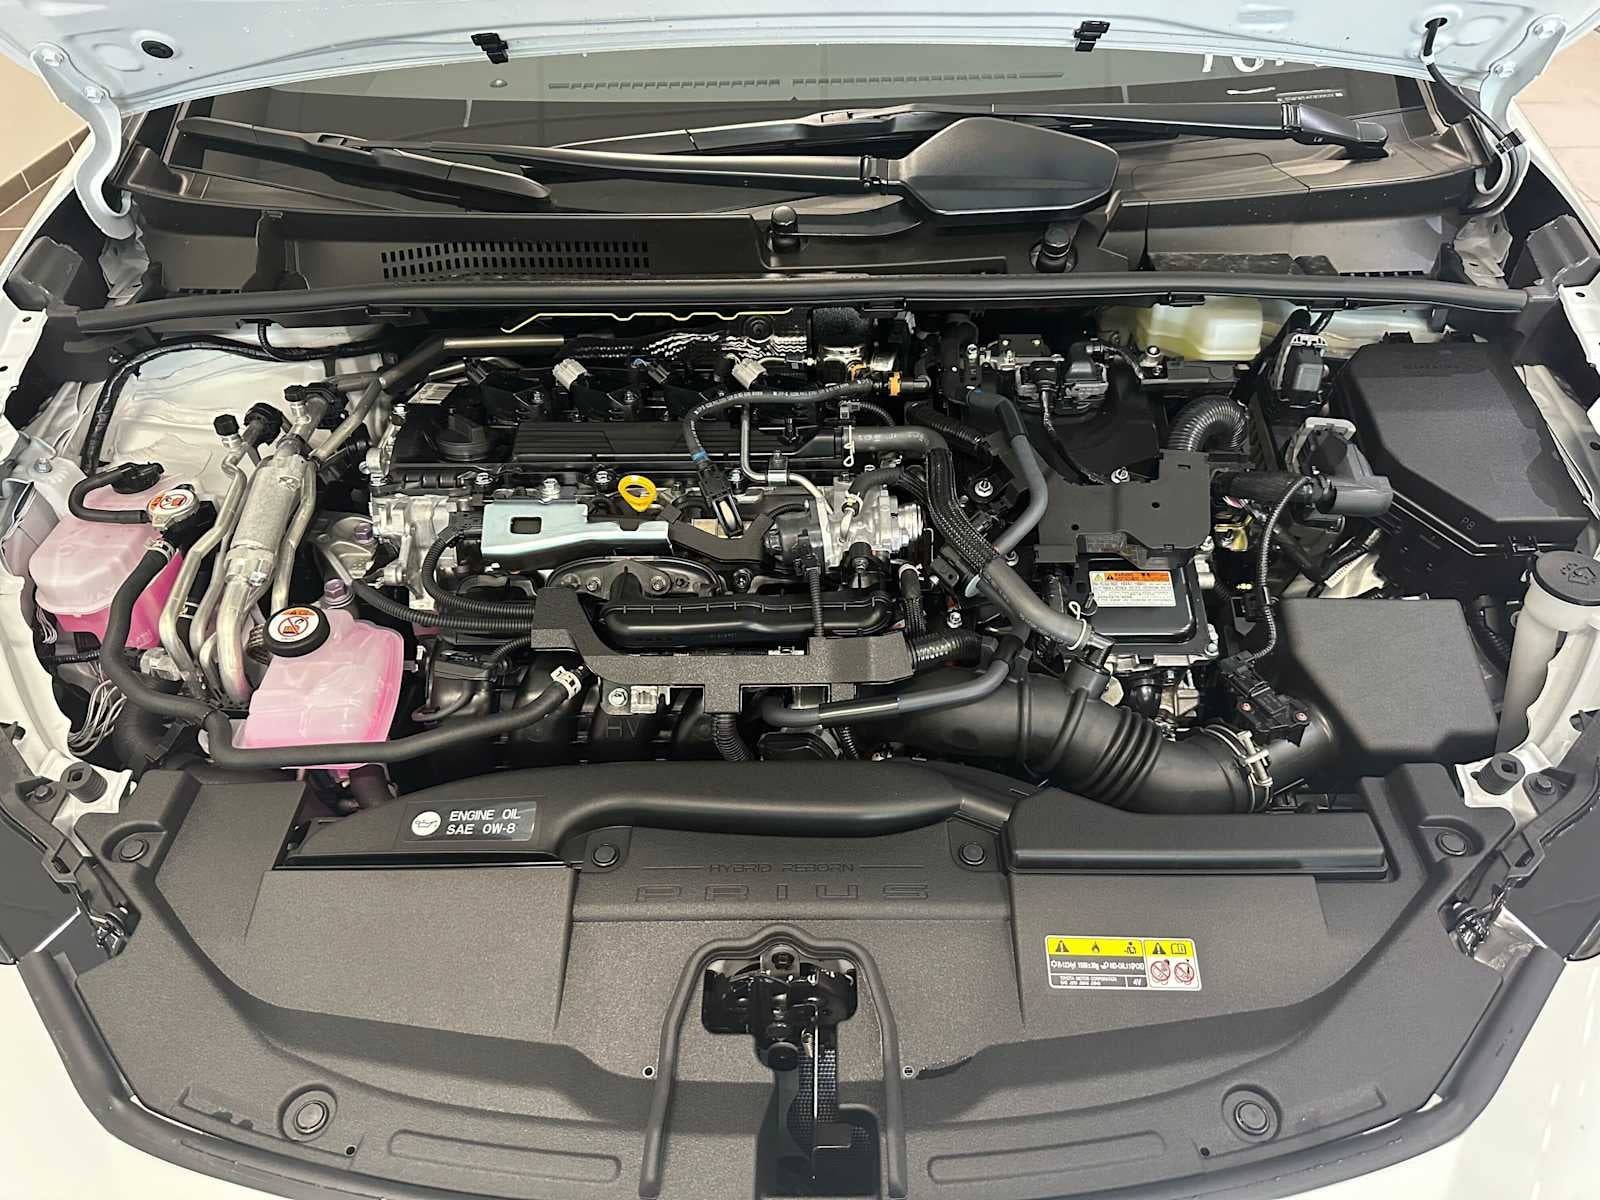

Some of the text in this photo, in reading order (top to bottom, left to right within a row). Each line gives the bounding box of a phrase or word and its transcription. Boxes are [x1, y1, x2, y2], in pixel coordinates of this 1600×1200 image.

[606, 718, 641, 738] HV
[450, 808, 521, 821] ENGINE OIL
[446, 823, 516, 835] SAE 0W-8
[708, 862, 855, 873] HYBRID REBORN
[635, 883, 928, 902] PRIUS
